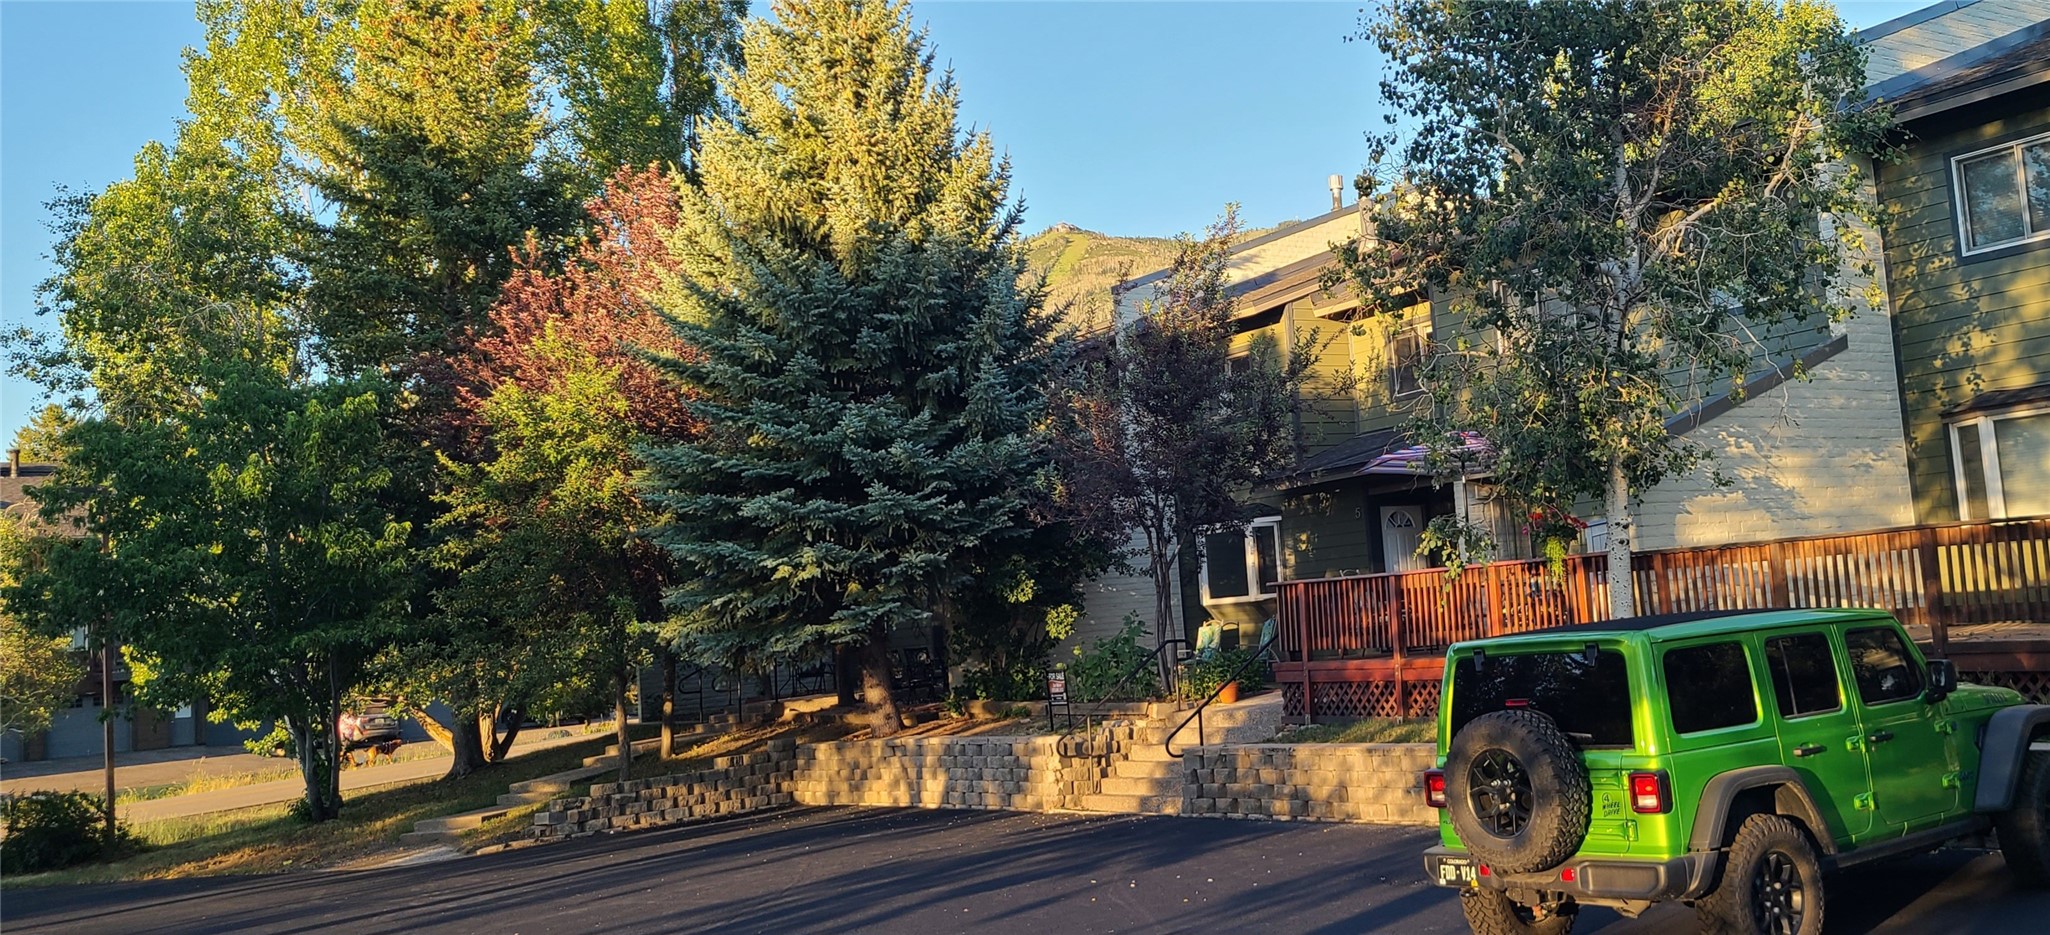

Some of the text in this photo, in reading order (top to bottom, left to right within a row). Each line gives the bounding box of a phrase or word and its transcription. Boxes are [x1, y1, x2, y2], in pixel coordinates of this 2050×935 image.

[1355, 507, 1361, 519] 5
[1056, 671, 1065, 680] SALE
[1603, 801, 1620, 809] WHEEL
[1603, 808, 1620, 817] DRIVE
